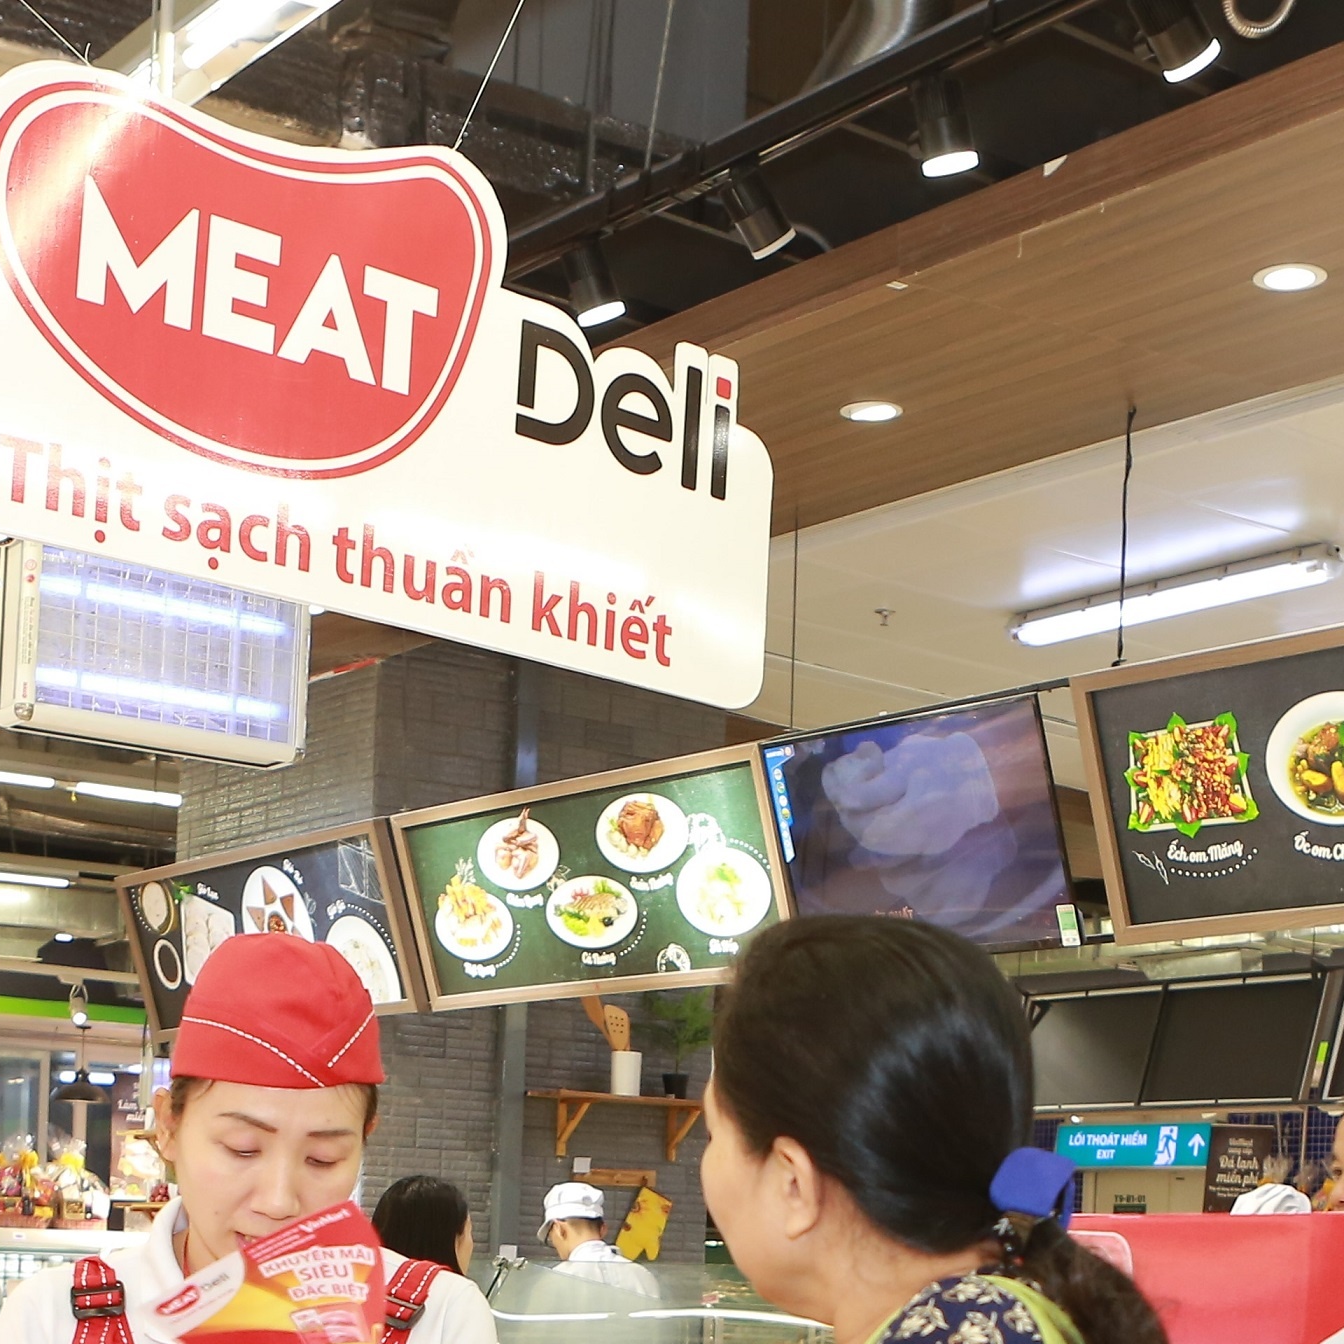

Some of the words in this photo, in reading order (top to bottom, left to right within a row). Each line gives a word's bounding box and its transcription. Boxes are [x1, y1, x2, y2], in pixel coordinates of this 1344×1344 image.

[76, 175, 439, 396] MEAT
[516, 319, 733, 501] Deli
[162, 492, 312, 572] sạch
[333, 524, 514, 625] thuần
[531, 571, 674, 668] khiết
[1189, 851, 1208, 863] om
[1311, 847, 1332, 860] om
[1068, 1131, 1085, 1146] LỐI
[1086, 1131, 1120, 1146] THOÁT
[1096, 1149, 1116, 1160] EXIT
